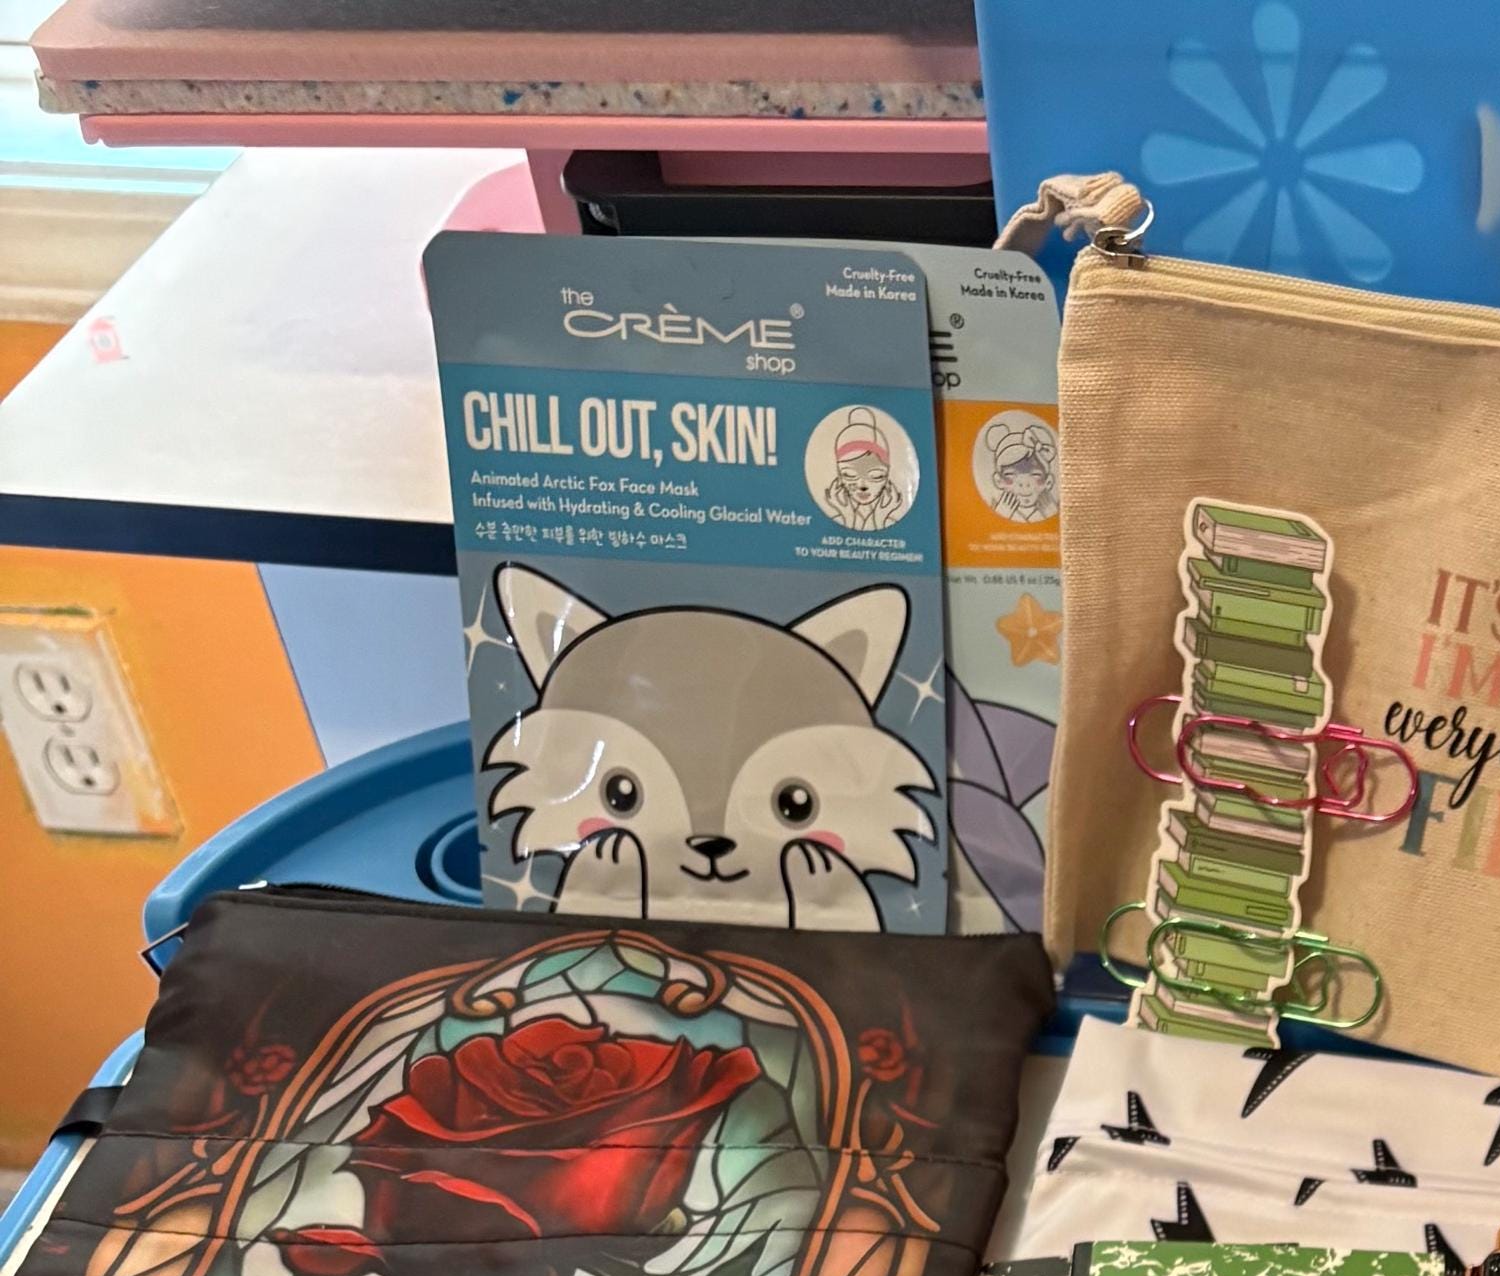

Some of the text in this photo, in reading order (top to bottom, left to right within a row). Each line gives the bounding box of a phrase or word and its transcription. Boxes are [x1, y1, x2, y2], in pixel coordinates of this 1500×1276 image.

[842, 266, 916, 284] Cruelty-Free
[974, 268, 1041, 284] Cruelty-Free
[560, 287, 594, 306] the
[825, 285, 916, 302] Made in Korea
[960, 285, 1045, 301] Made in Korea
[745, 353, 796, 375] shop
[463, 390, 778, 468] CHILL OUT, SKIN!
[471, 470, 699, 497] Animated Arctic Fox Face Mask
[472, 493, 812, 526] Infused with Hydrating & Cooling Glacial Water
[475, 521, 496, 540] 수분
[650, 533, 687, 550] 마스크
